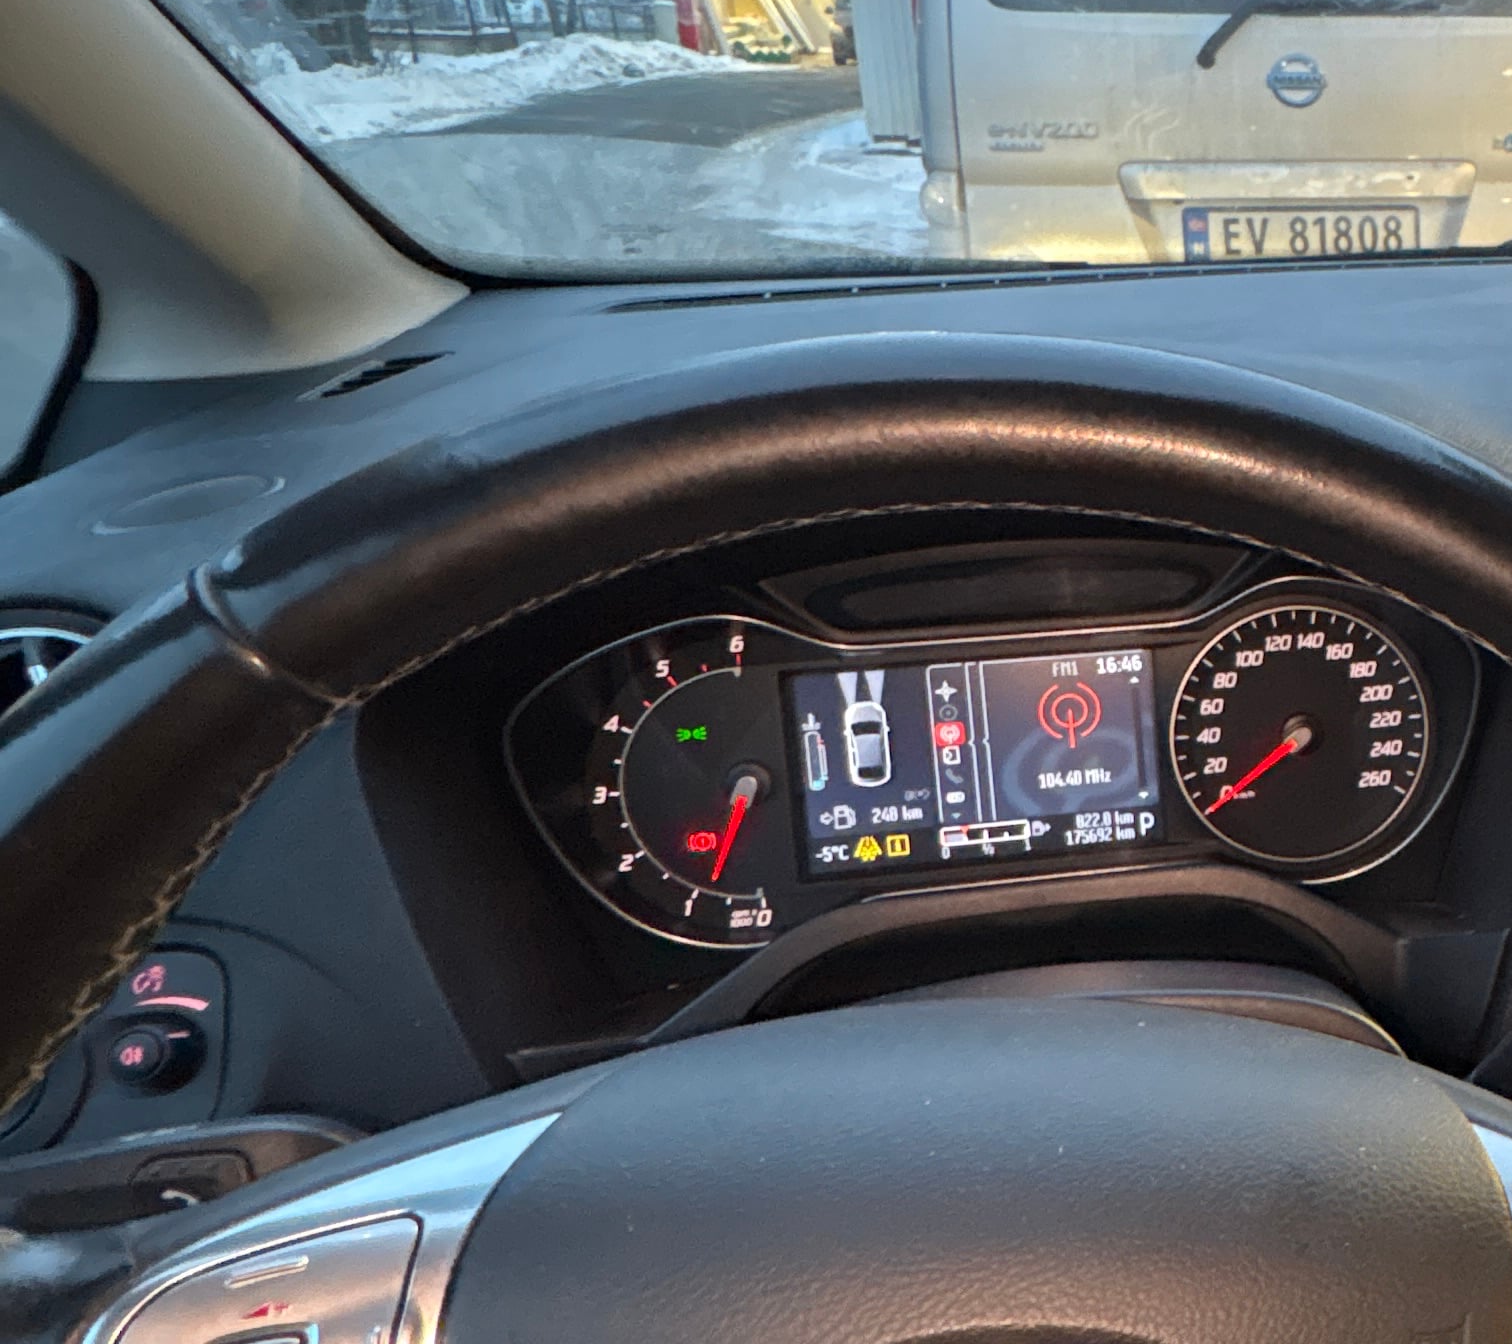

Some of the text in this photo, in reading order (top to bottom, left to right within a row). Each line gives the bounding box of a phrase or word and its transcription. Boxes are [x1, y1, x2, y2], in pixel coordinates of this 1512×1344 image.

[1223, 215, 1404, 256] EV 81808
[730, 635, 745, 653] 6
[1265, 634, 1292, 652] 120
[1297, 632, 1325, 649] 140
[1235, 650, 1264, 667] 100
[1325, 643, 1354, 661] 160
[655, 659, 671, 678] 5
[1052, 660, 1078, 677] FM1
[1096, 655, 1143, 676] 16:46
[1349, 660, 1377, 678] 180
[1212, 671, 1238, 689] 80
[1359, 684, 1393, 702] 200
[1200, 698, 1224, 716] 60
[602, 714, 620, 733] 4
[1369, 710, 1402, 729] 220
[1196, 727, 1221, 744] 40
[1369, 739, 1403, 757] 240
[1203, 757, 1228, 774] 20
[1038, 767, 1112, 790] 104.40 MHz
[1358, 770, 1392, 788] 260
[592, 786, 608, 805] 3
[901, 804, 924, 821] km
[1114, 810, 1135, 825] km
[1139, 811, 1155, 837] P
[1064, 825, 1136, 846] 175692 km
[815, 844, 850, 863] -5°C
[618, 854, 634, 872] 2
[683, 898, 695, 917] 1
[756, 909, 773, 927] 0
